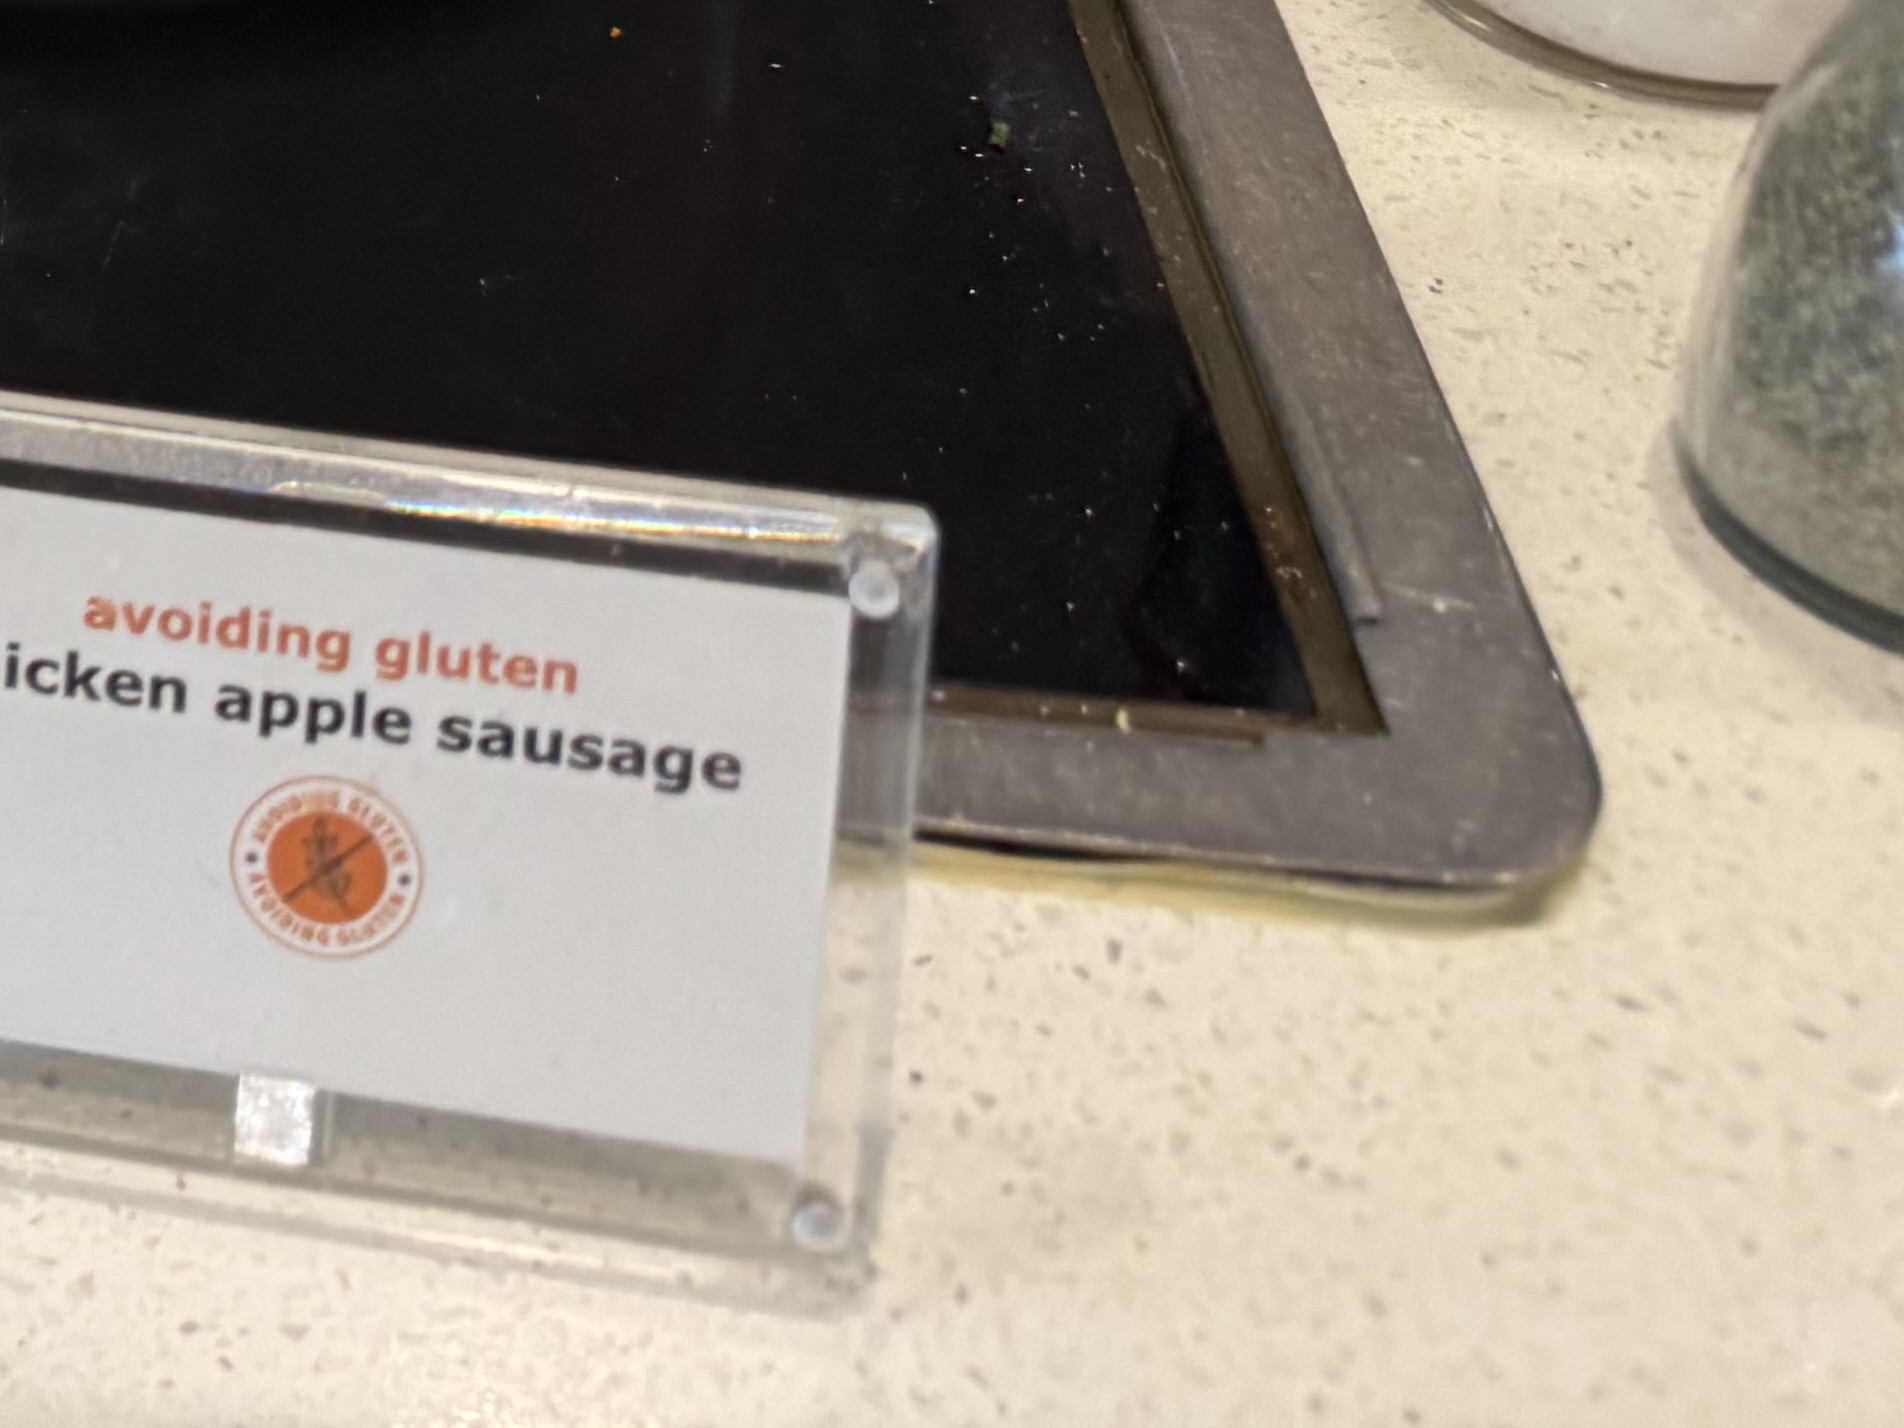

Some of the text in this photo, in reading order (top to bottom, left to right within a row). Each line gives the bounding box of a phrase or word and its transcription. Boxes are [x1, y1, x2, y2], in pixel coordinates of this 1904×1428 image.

[82, 590, 579, 695] avoiding gluten
[214, 681, 411, 745] apple
[436, 709, 743, 794] sausage
